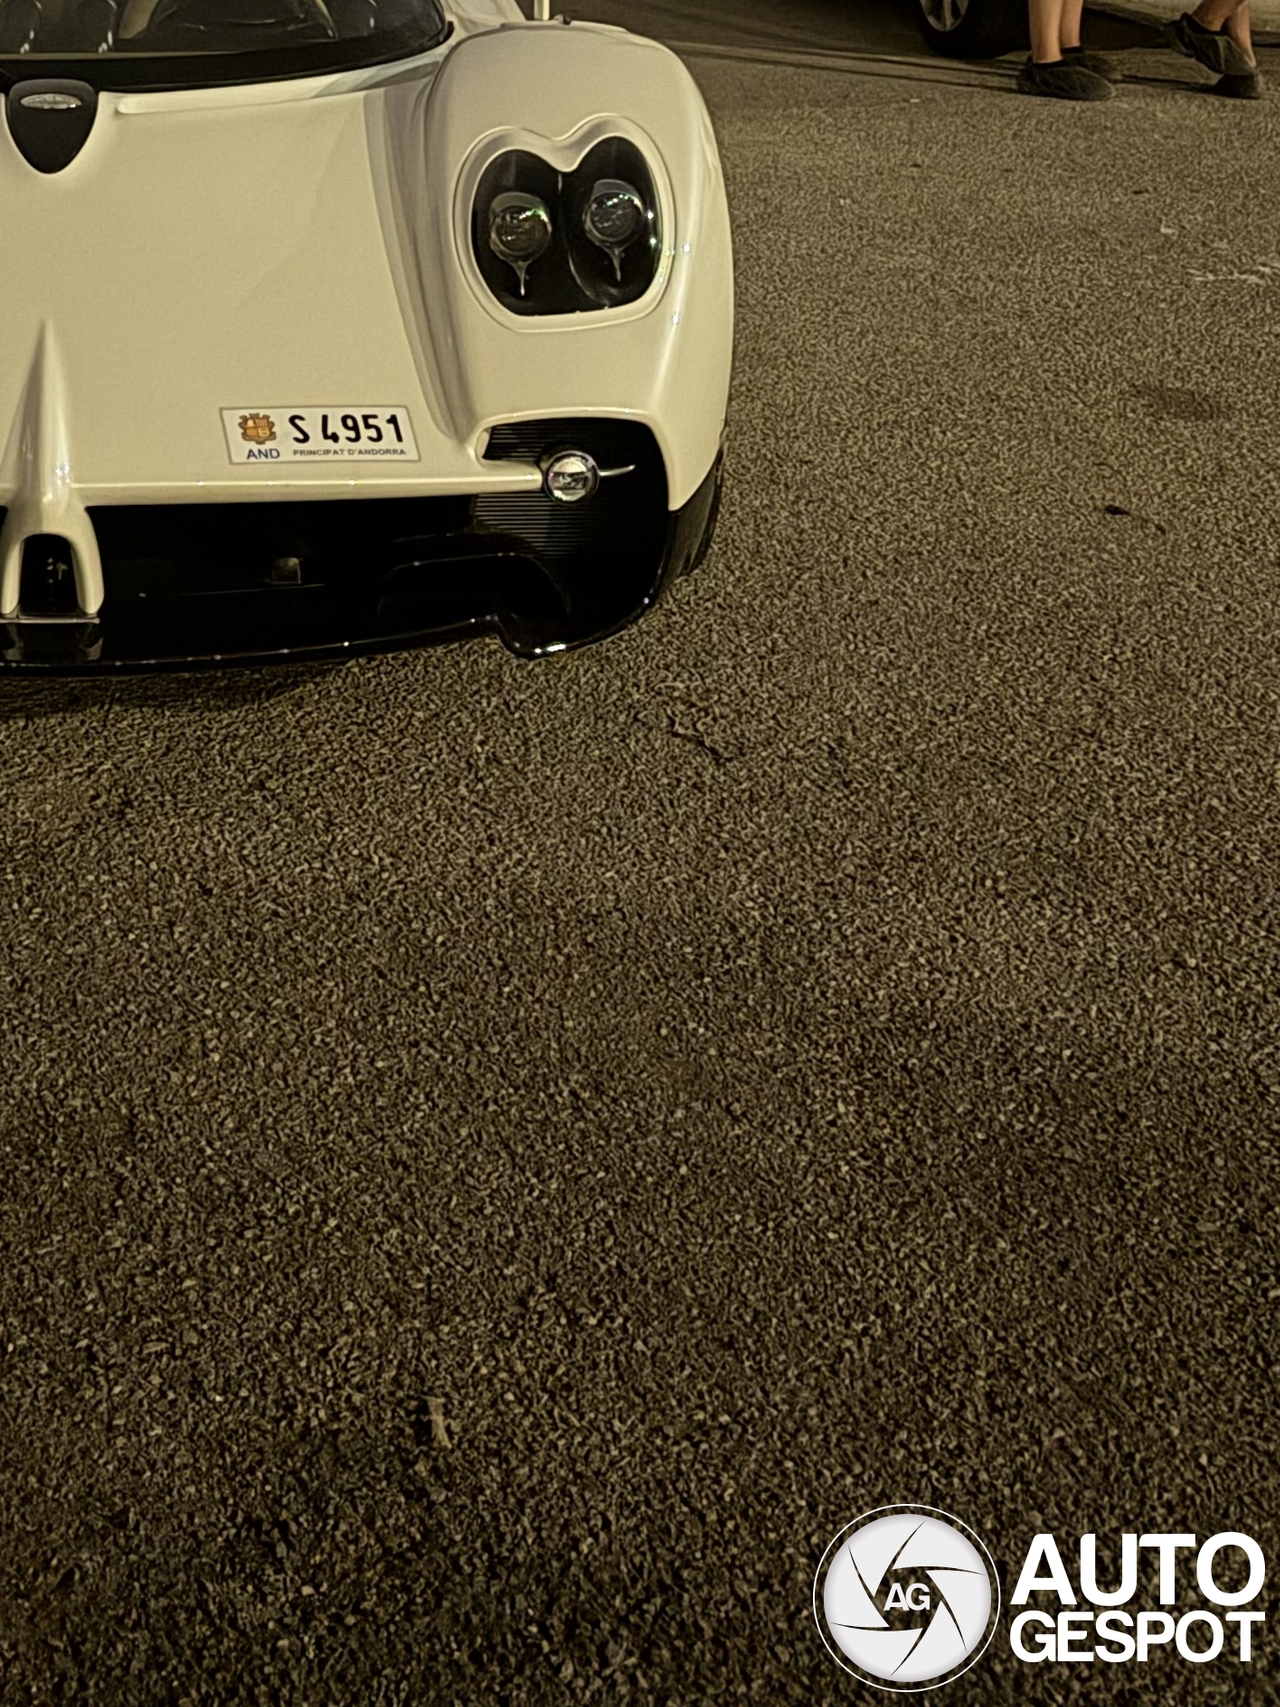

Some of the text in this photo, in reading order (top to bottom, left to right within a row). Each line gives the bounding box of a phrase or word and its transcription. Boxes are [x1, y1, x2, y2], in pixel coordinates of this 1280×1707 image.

[288, 414, 404, 444] S 4951
[246, 448, 281, 460] AND
[347, 448, 407, 456] D'ANDORRA
